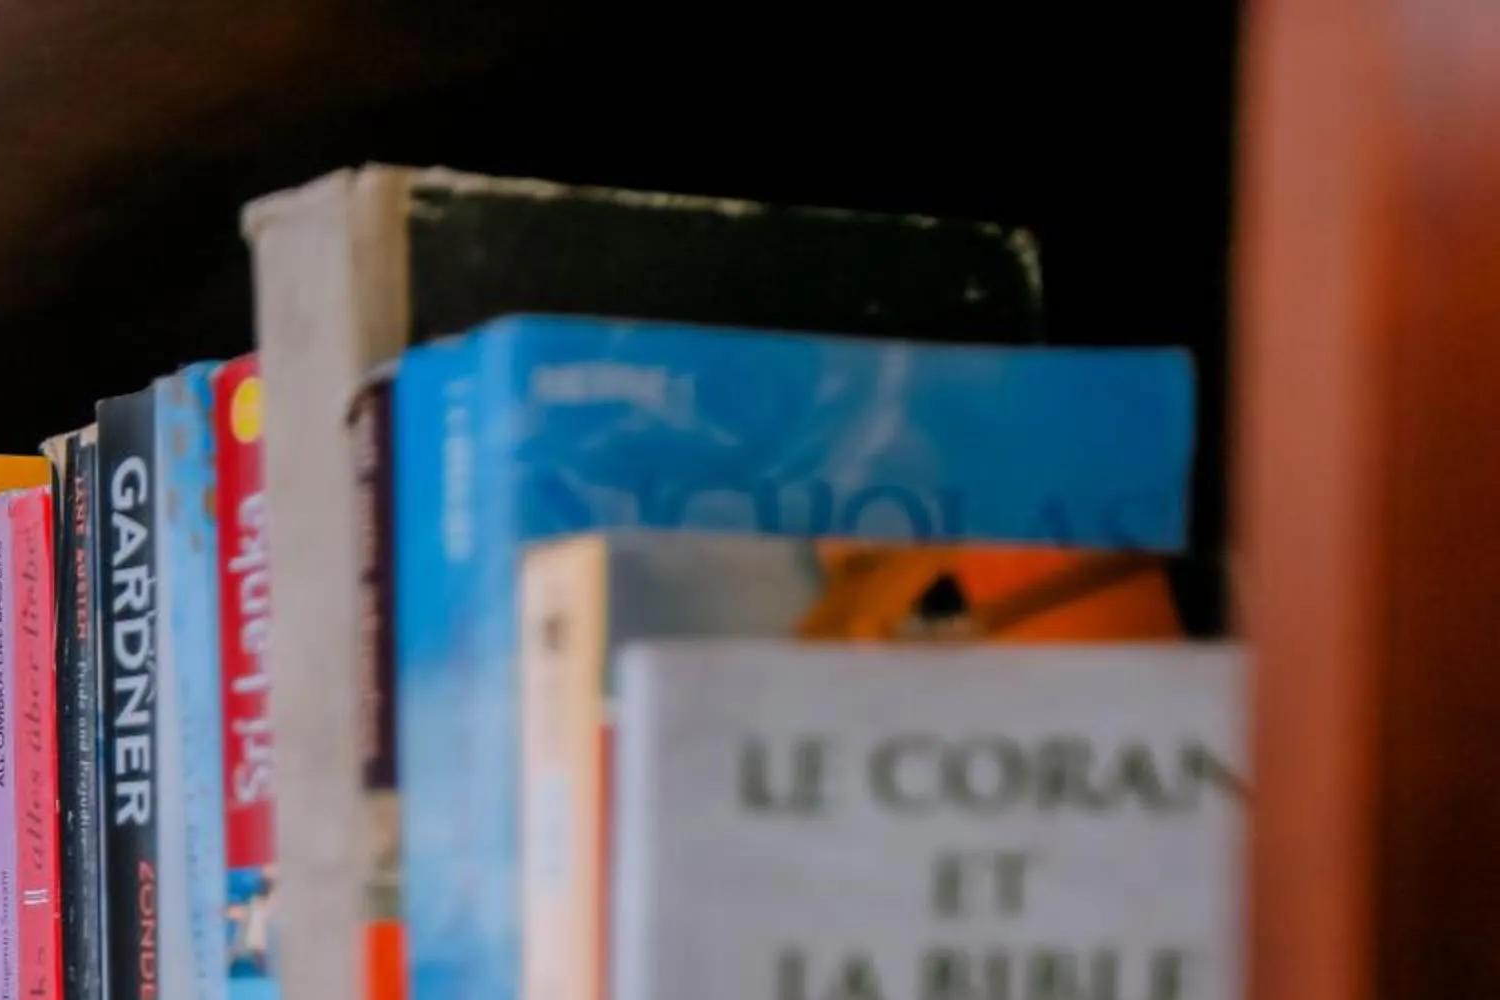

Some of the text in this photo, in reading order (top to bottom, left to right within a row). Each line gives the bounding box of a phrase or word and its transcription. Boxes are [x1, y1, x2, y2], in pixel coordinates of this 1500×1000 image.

[111, 455, 151, 826] GARDNER
[738, 733, 1257, 815] LE CORAN
[932, 850, 1040, 919] ET
